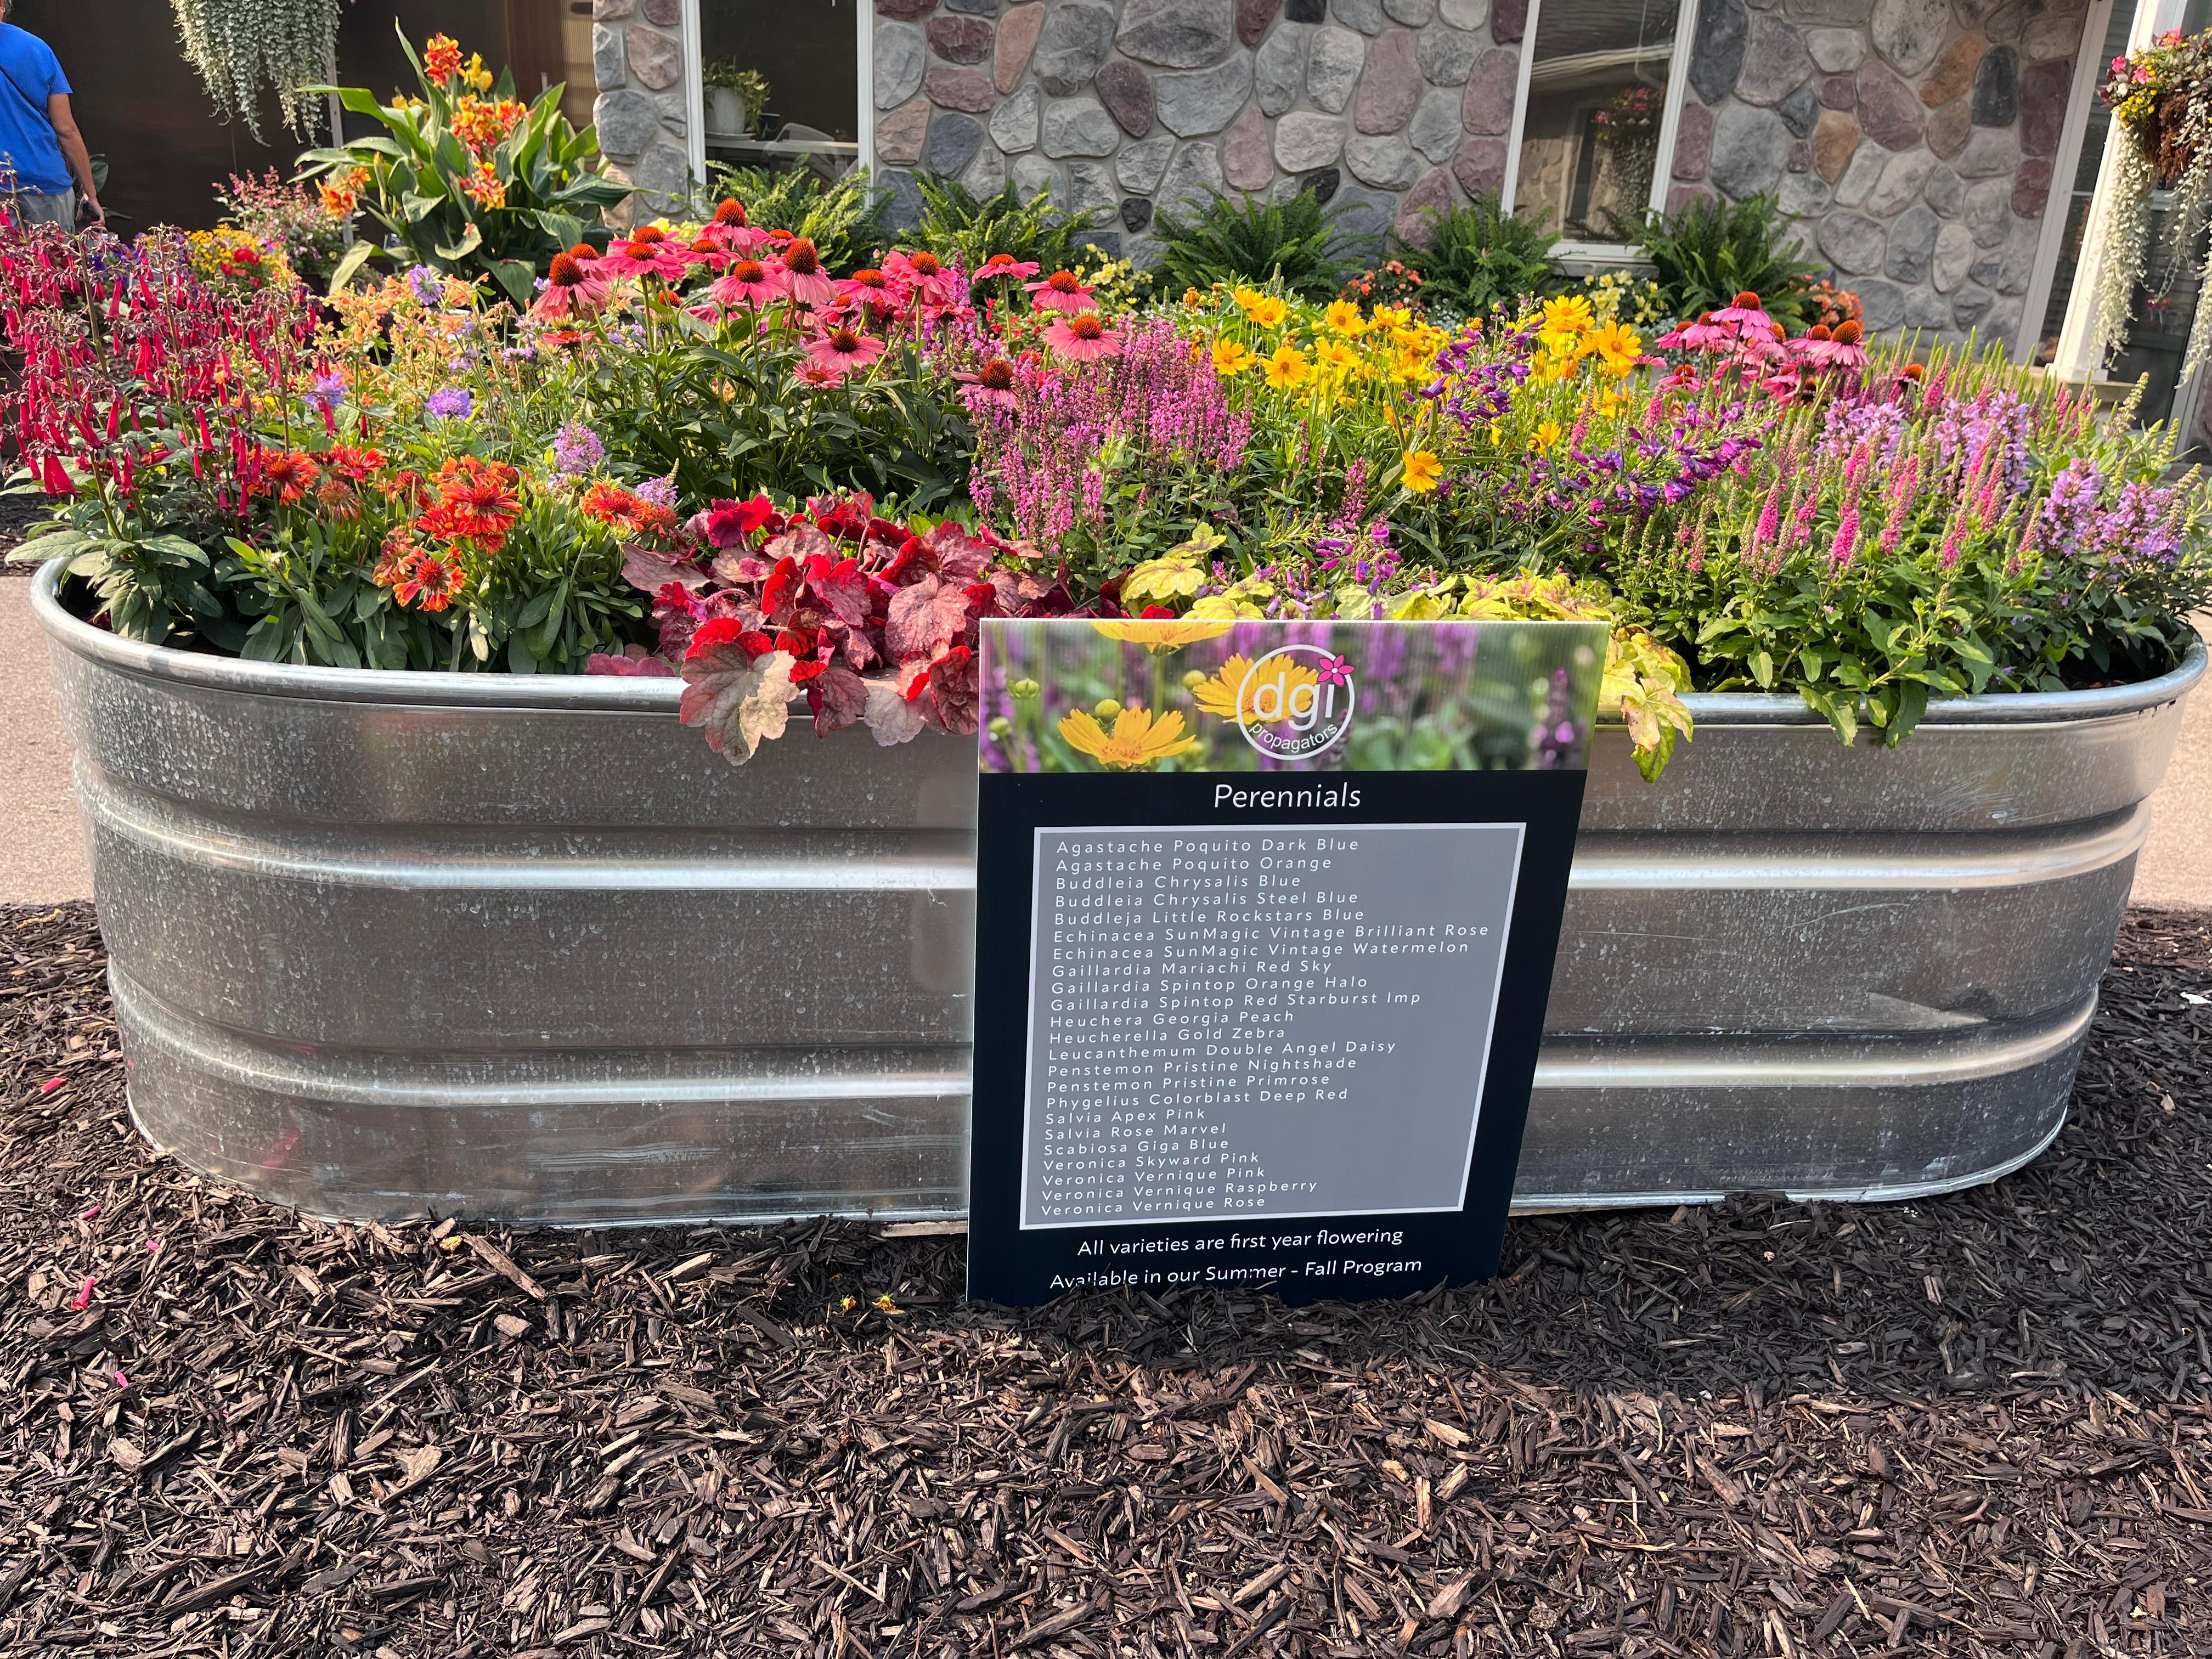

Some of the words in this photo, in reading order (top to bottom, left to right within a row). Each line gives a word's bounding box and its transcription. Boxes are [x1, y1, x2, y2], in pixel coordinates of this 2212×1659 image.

[1253, 672, 1335, 731] dgi
[1249, 722, 1338, 753] propagators
[1214, 781, 1361, 808] Perennials
[1056, 839, 1163, 857] Agastache
[1174, 839, 1251, 855] Poquito
[1262, 838, 1306, 851] Dark
[1317, 838, 1358, 850] Blue
[1056, 858, 1161, 875] Agastache
[1173, 857, 1249, 873] Poquito
[1260, 856, 1331, 872] Orange
[1056, 876, 1143, 890] Buddleia
[1155, 874, 1248, 891] Chrysalis
[1259, 874, 1300, 887] Blue
[1056, 894, 1142, 907] Buddleia
[1154, 892, 1246, 909] Chrysalis
[1257, 891, 1306, 904] Steel
[1317, 891, 1357, 903] Blue
[1055, 912, 1141, 927] Buddleja
[1153, 910, 1206, 923] Little
[1217, 909, 1312, 922] Rockstars
[1323, 908, 1363, 921] Blue
[1054, 930, 1154, 943] Echinacea
[1165, 927, 1260, 943] SunMagic
[1270, 927, 1345, 941] Vintage
[1355, 924, 1435, 937] Brilliant
[1445, 924, 1488, 936] Rose
[1053, 947, 1153, 960] Echinacea
[1164, 944, 1258, 960] SunMagic
[1268, 944, 1342, 958] Vintage
[1353, 941, 1468, 954] Watermelon
[1052, 963, 1150, 977] Gaillardia
[1162, 961, 1246, 974] Mariachi
[1256, 960, 1290, 973] Red
[1300, 960, 1331, 974] Sky
[1052, 980, 1149, 994] Gaillardia
[1160, 979, 1235, 994] Spintop
[1245, 978, 1314, 992] Orange
[1325, 975, 1367, 988] Halo
[1051, 997, 1148, 1011] Gaillardia
[1159, 996, 1233, 1011] Spintop
[1244, 994, 1277, 1006] Red
[1287, 992, 1377, 1006] Starburst
[1387, 992, 1420, 1006] Imp
[1051, 1014, 1142, 1028] Heuchera
[1153, 1012, 1228, 1026] Georgia
[1239, 1010, 1293, 1023] Peach
[1049, 1029, 1167, 1044] Heucherella
[1178, 1028, 1222, 1041] Gold
[1232, 1027, 1284, 1039] Zebra
[1049, 1046, 1195, 1060] Leucanthemum
[1206, 1043, 1273, 1056] Double
[1282, 1041, 1335, 1056] Angel
[1346, 1040, 1396, 1054] Daisy
[1048, 1065, 1153, 1077] Penstemon
[1164, 1060, 1238, 1073] Pristine
[1248, 1057, 1356, 1073] Nightshade
[1047, 1081, 1152, 1093] Penstemon
[1163, 1076, 1237, 1089] Pristine
[1246, 1075, 1329, 1086] Primrose
[1047, 1095, 1139, 1110] Phygelius
[1149, 1092, 1250, 1105] Colorblast
[1260, 1091, 1305, 1103] Deep
[1316, 1088, 1347, 1100] Red
[1046, 1111, 1101, 1125] Salvia
[1111, 1111, 1156, 1124] Apex
[1166, 1108, 1205, 1120] Pink
[1045, 1127, 1100, 1140] Salvia
[1111, 1126, 1153, 1137] Rose
[1164, 1122, 1226, 1135] Marvel
[1044, 1143, 1127, 1156] Scabiosa
[1137, 1141, 1179, 1154] Giga
[1189, 1138, 1228, 1150] Blue
[1043, 1158, 1125, 1171] Veronica
[1136, 1153, 1210, 1169] Skyward
[1221, 1152, 1259, 1164] Pink
[1042, 1173, 1124, 1186] Veronica
[1135, 1170, 1217, 1182] Vernique
[1227, 1166, 1265, 1178] Pink
[1042, 1188, 1123, 1201] Veronica
[1133, 1184, 1216, 1197] Vernique
[1226, 1181, 1317, 1194] Raspberry
[1041, 1203, 1122, 1216] Veronica
[1132, 1199, 1214, 1212] Vernique
[1224, 1197, 1265, 1207] Rose
[1077, 1239, 1103, 1256] All
[1110, 1237, 1189, 1254] varieties
[1195, 1239, 1224, 1251] are
[1230, 1233, 1267, 1249] first
[1272, 1235, 1312, 1250] year
[1317, 1228, 1404, 1245] flowering
[1049, 1269, 1138, 1289] Available
[1144, 1269, 1160, 1283] in
[1167, 1265, 1200, 1282] our
[1205, 1266, 1286, 1281] Summer
[1305, 1260, 1336, 1277] Fall
[1343, 1260, 1422, 1277] Program
